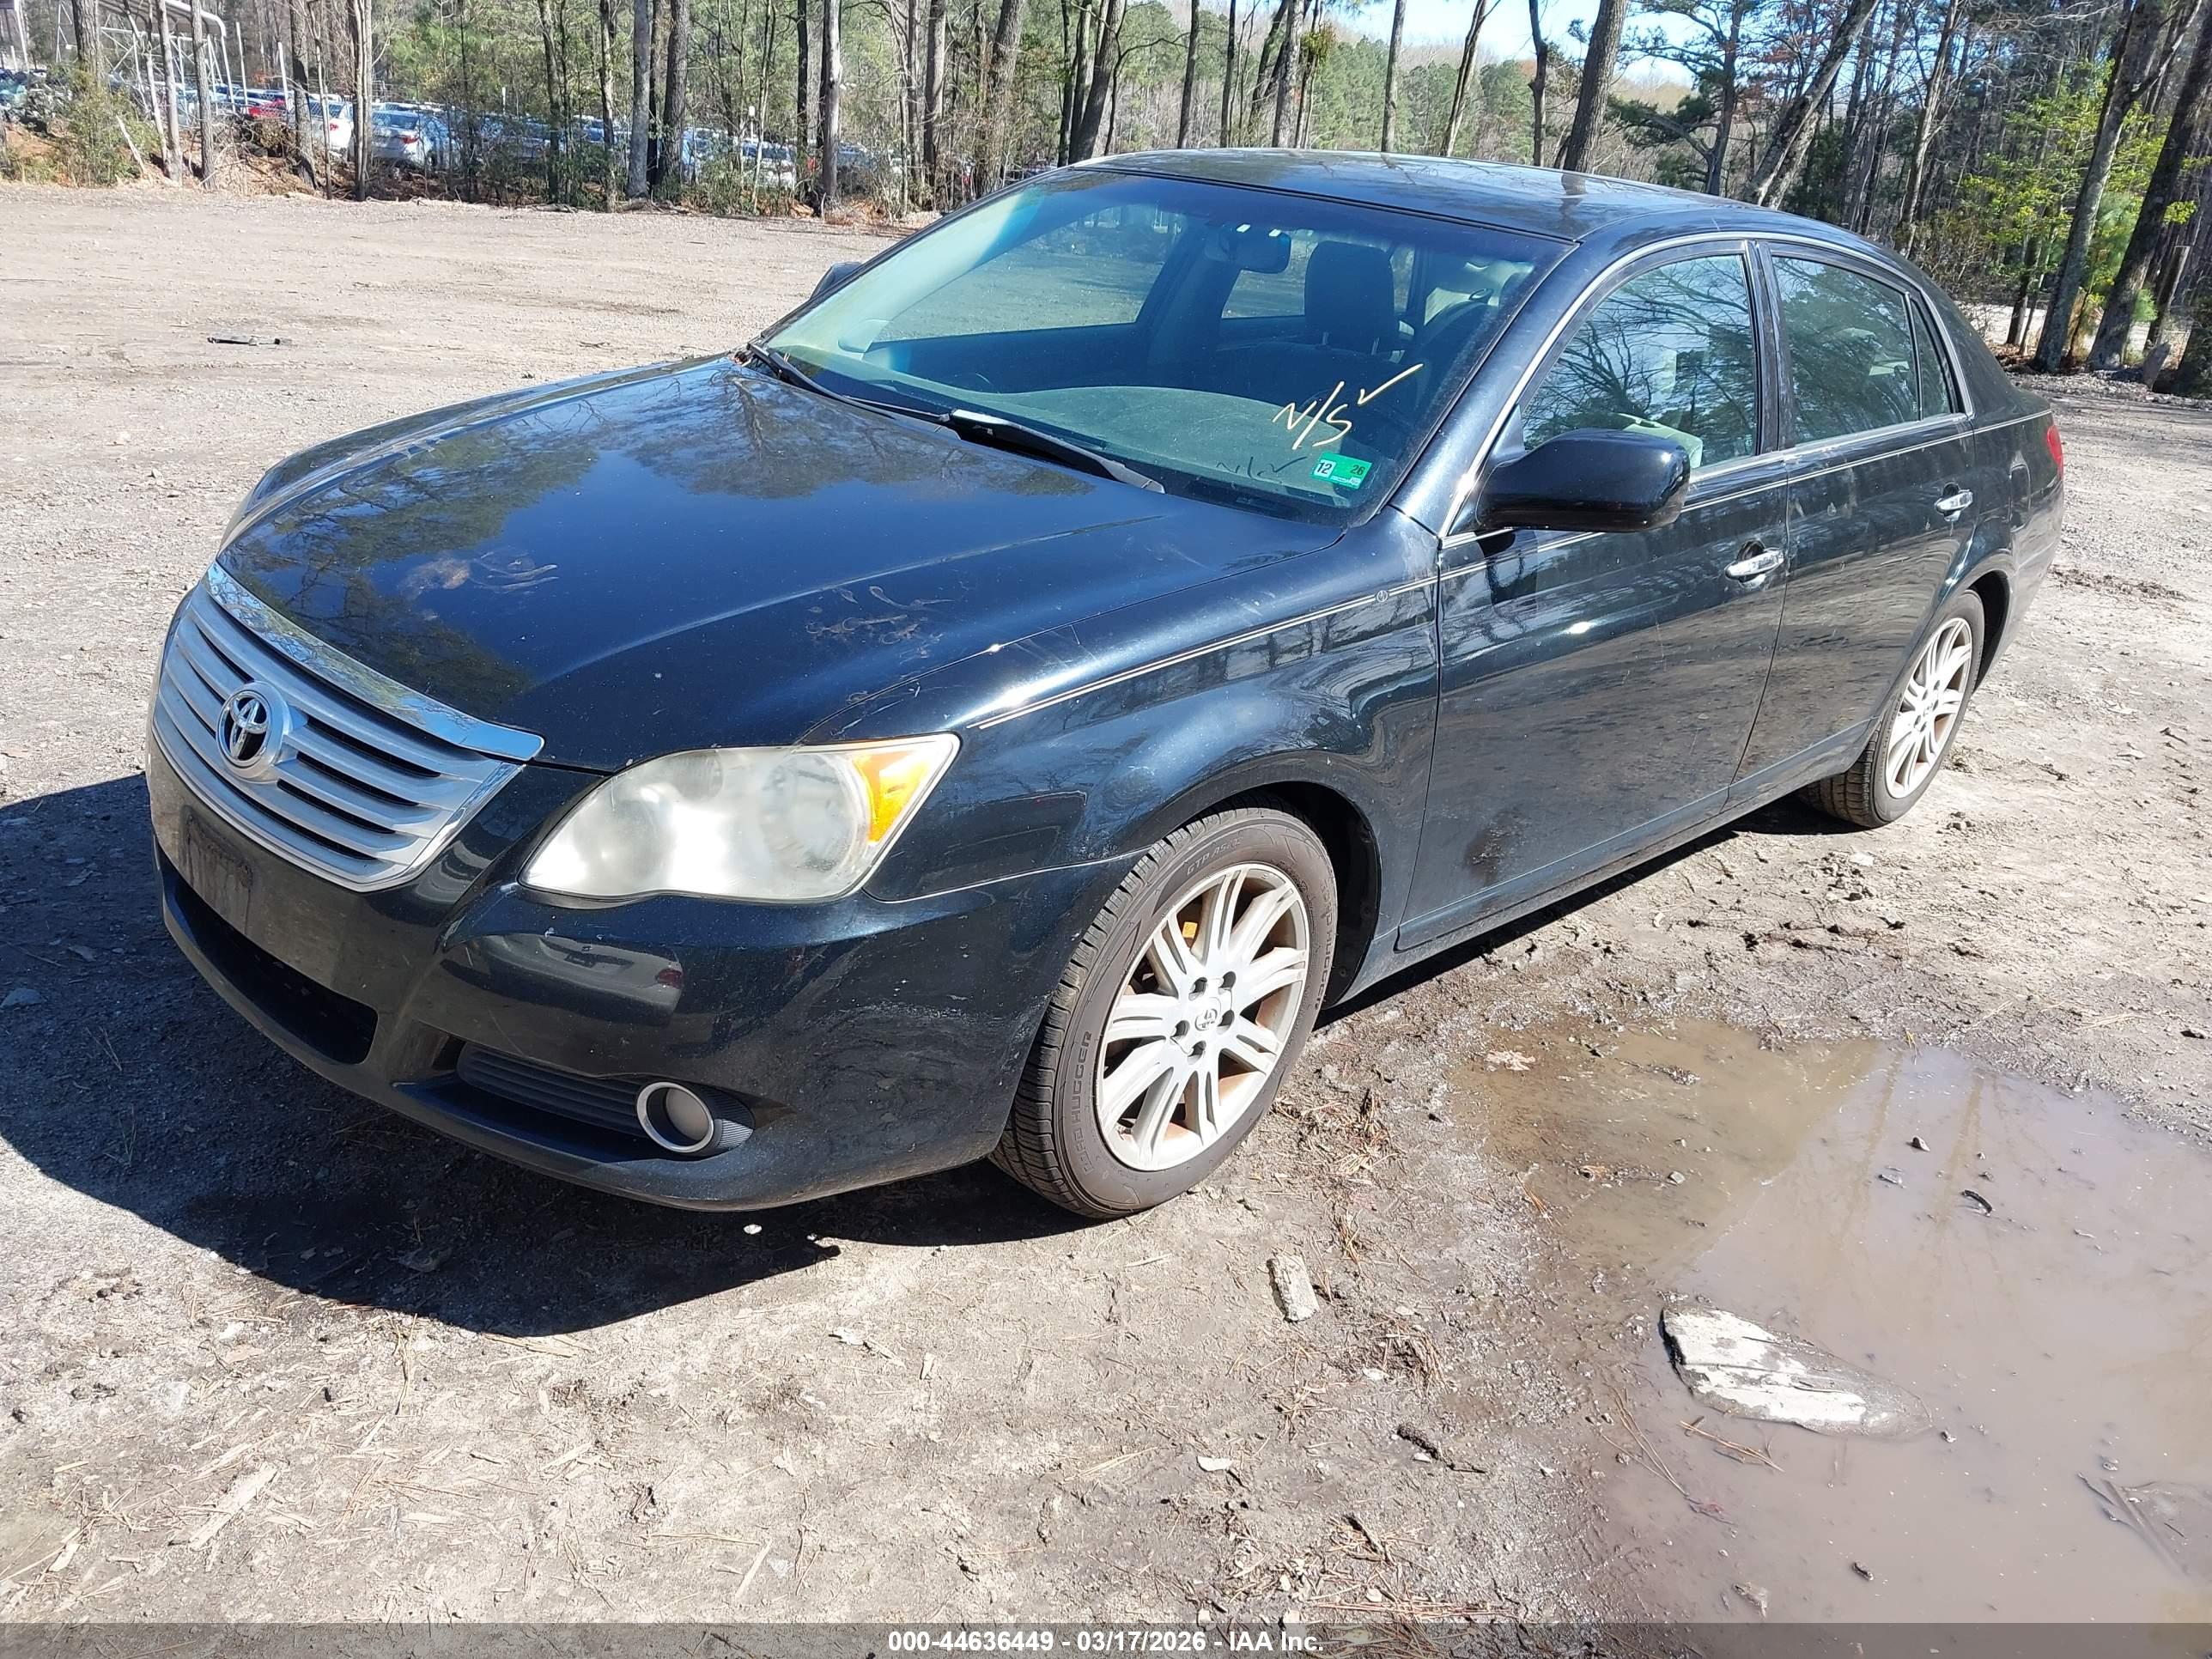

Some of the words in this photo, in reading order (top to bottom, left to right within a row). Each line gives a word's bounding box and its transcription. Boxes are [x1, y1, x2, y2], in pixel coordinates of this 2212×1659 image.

[1273, 380, 1352, 450] N/S
[1316, 462, 1333, 475] 12
[1350, 465, 1365, 476] 26
[1071, 1030, 1093, 1123] HUGGER
